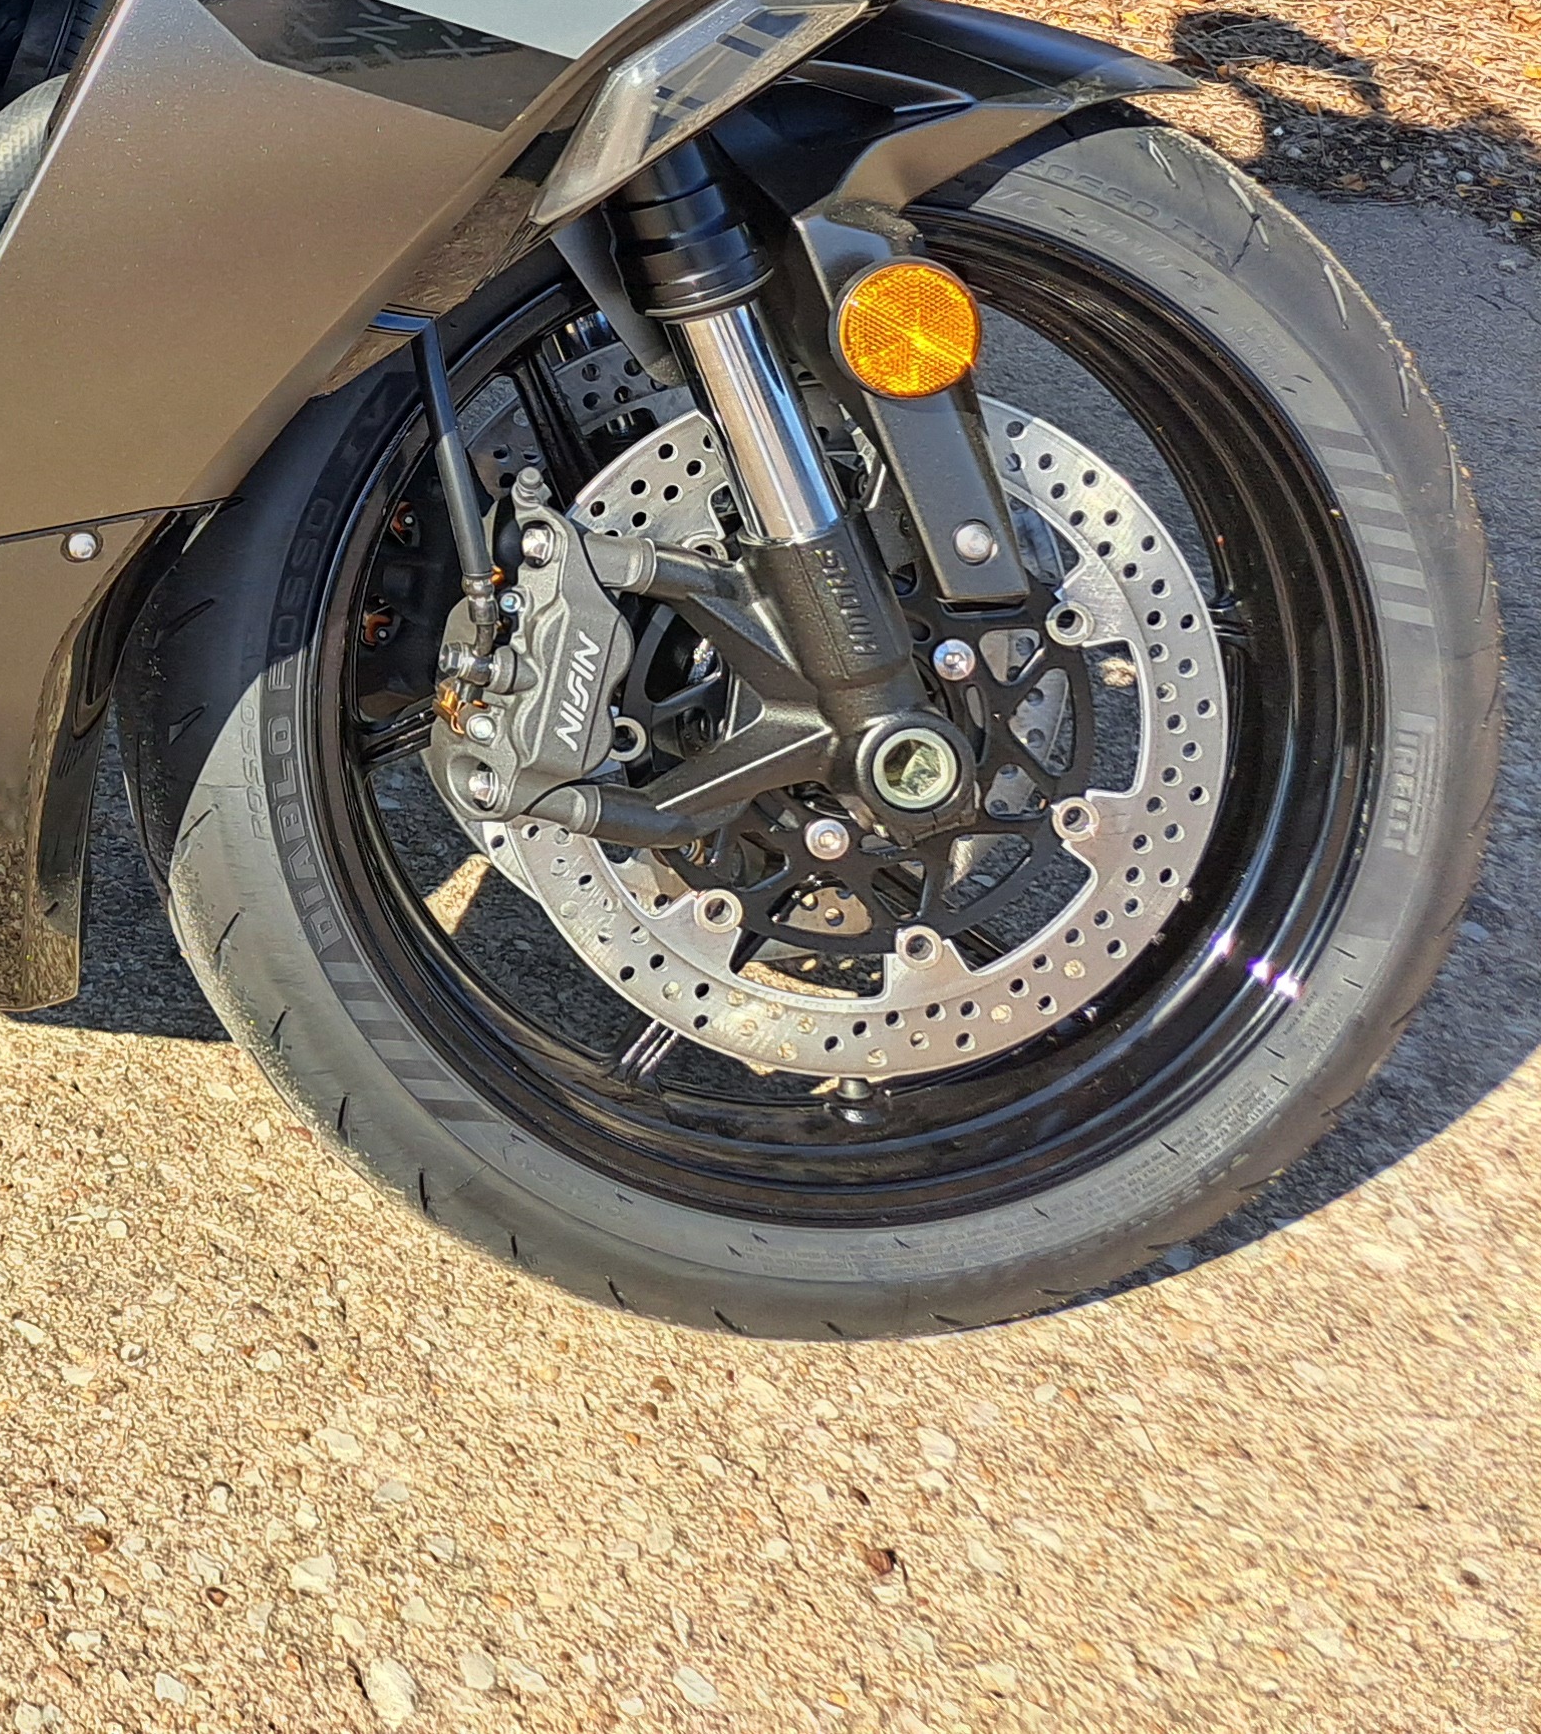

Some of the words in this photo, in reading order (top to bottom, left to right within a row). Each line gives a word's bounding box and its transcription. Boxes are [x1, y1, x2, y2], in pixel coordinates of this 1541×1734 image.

[268, 497, 336, 692] ROSSO
[554, 630, 603, 752] NISSIN
[240, 699, 271, 842] ROSSO
[266, 715, 344, 956] DIABLO
[1381, 709, 1439, 858] PIRELLI
